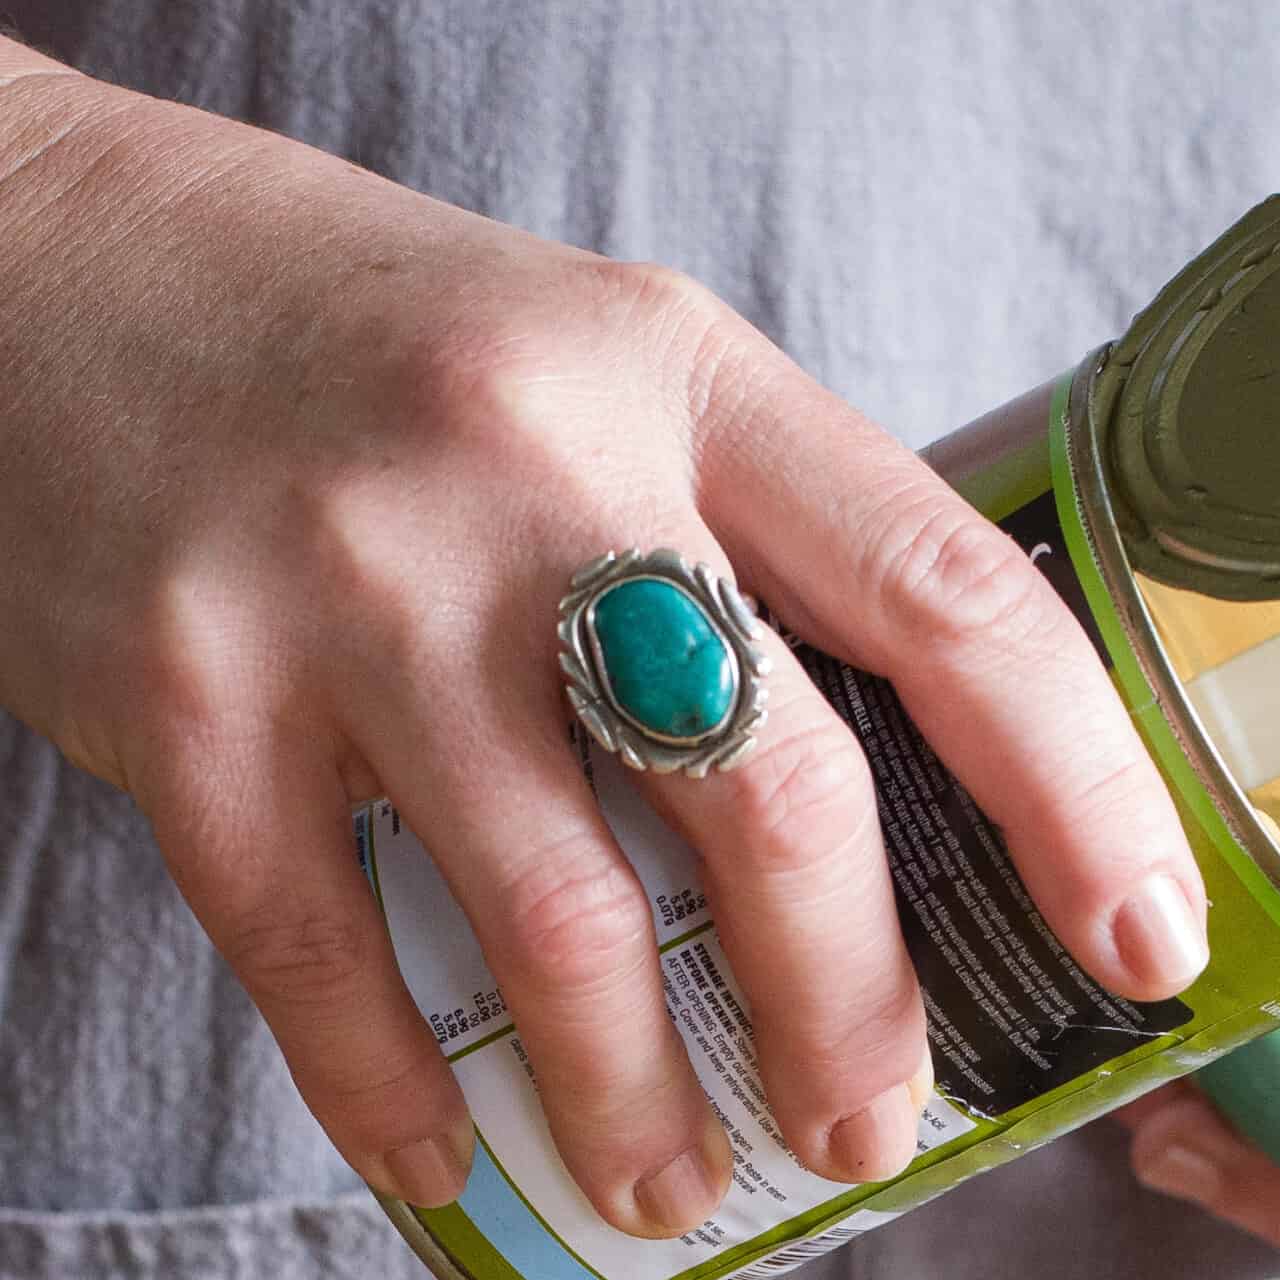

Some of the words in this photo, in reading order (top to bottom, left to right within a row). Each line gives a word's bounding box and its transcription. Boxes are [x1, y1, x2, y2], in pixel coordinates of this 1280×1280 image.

[655, 894, 676, 926] 0.07g
[910, 800, 937, 838] another
[951, 878, 978, 910] Adjust
[969, 905, 997, 941] heating
[1002, 953, 1036, 995] according
[927, 801, 950, 830] cover
[941, 826, 963, 851] with
[952, 847, 990, 899] micro-safe
[1003, 931, 1022, 950] and
[1014, 946, 1036, 967] heat
[429, 1012, 448, 1044] 0.07g
[442, 1013, 459, 1039] 5.8g
[453, 1007, 470, 1033] 6.9g
[472, 991, 491, 1022] 12.0g
[665, 955, 692, 989] AFTER
[684, 987, 719, 1035] OPENING:
[711, 1032, 736, 1062] Empty
[731, 1060, 747, 1078] out
[678, 948, 710, 991] BEFORE
[702, 989, 739, 1038] OPENING:
[733, 1036, 754, 1061] Store
[691, 941, 726, 990] STORAGE
[719, 988, 758, 1042] INSTRUCTI
[657, 969, 684, 1008] ntainer.
[677, 1007, 702, 1036] Cover
[694, 1033, 714, 1053] and
[707, 1051, 728, 1075] keep
[757, 1116, 775, 1134] Use
